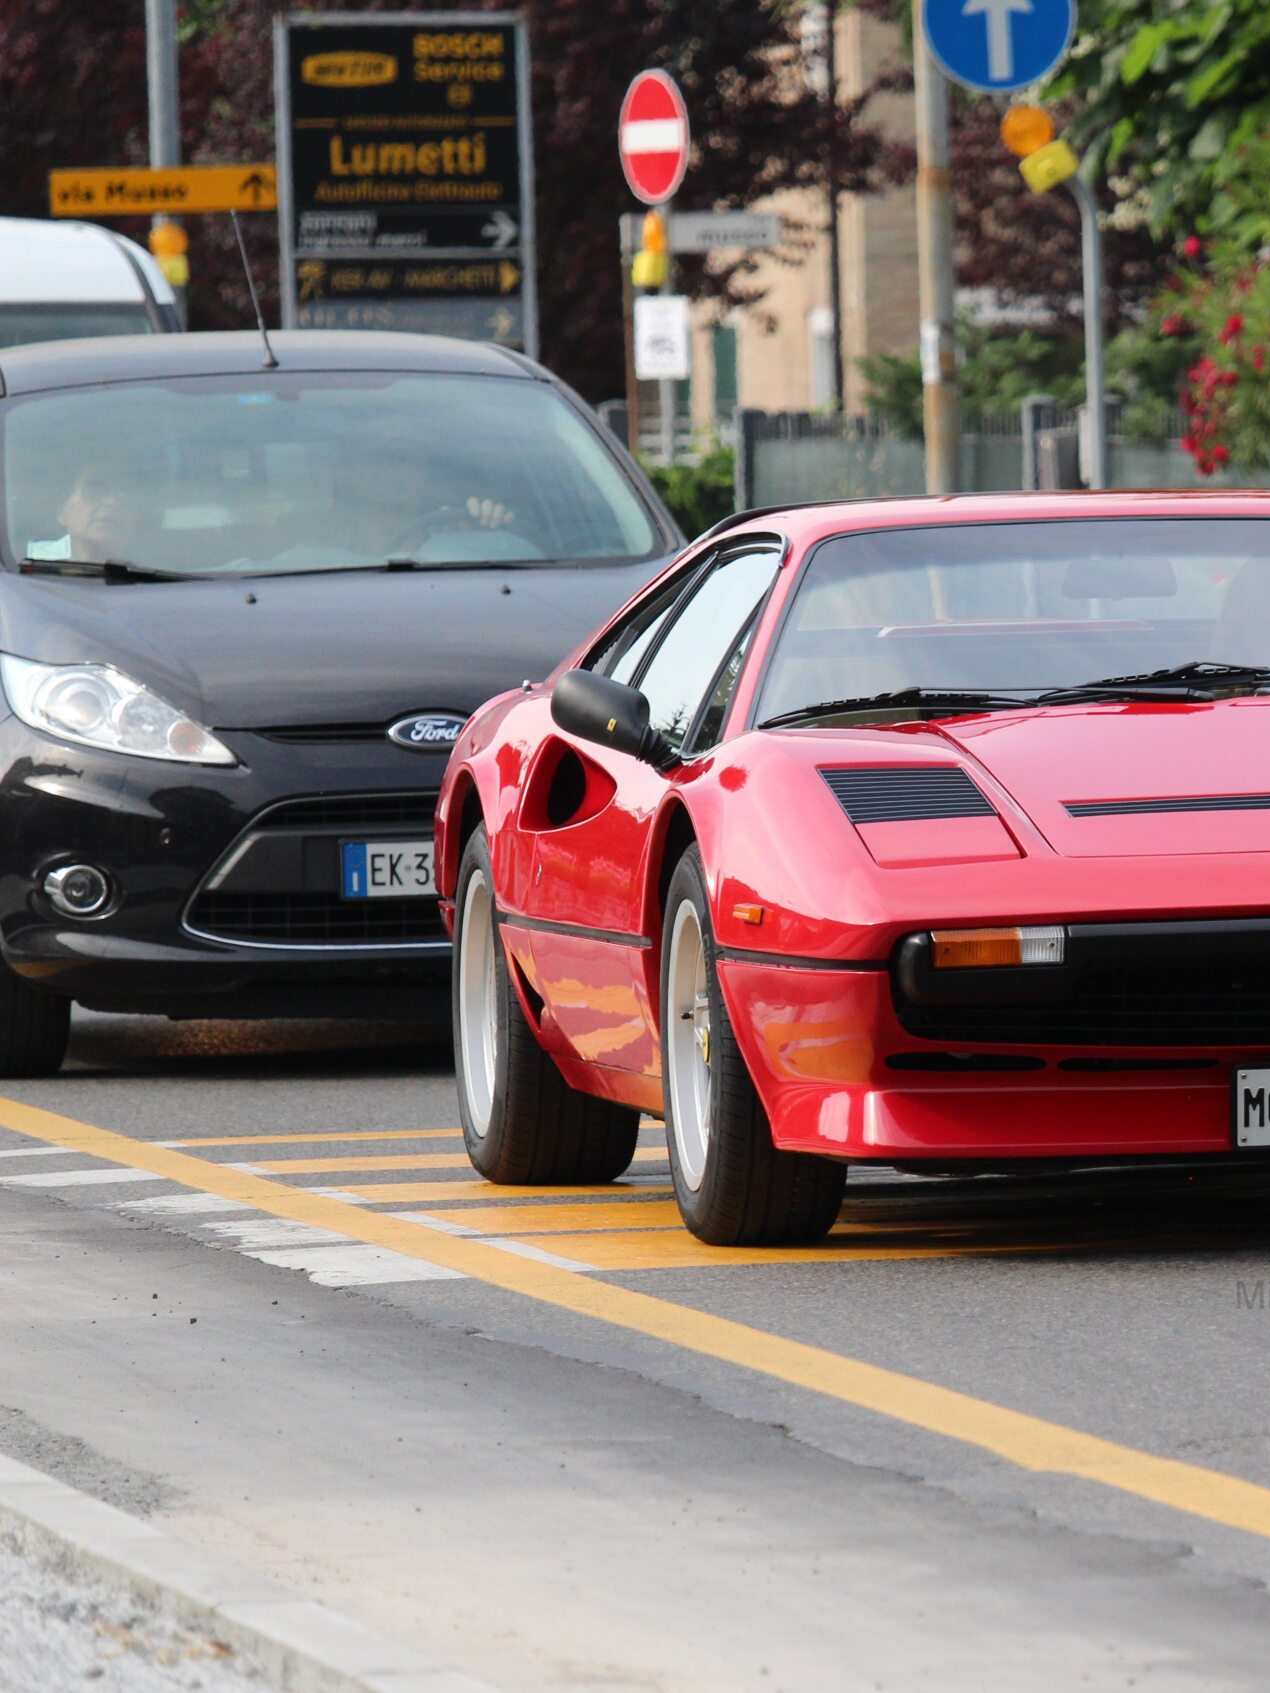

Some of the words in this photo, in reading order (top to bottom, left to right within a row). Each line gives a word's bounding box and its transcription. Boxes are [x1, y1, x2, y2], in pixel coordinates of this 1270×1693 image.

[413, 33, 504, 58] BOSCH
[414, 59, 504, 81] Service
[330, 131, 487, 175] Lumetti
[59, 184, 94, 203] via
[410, 719, 462, 742] Ford
